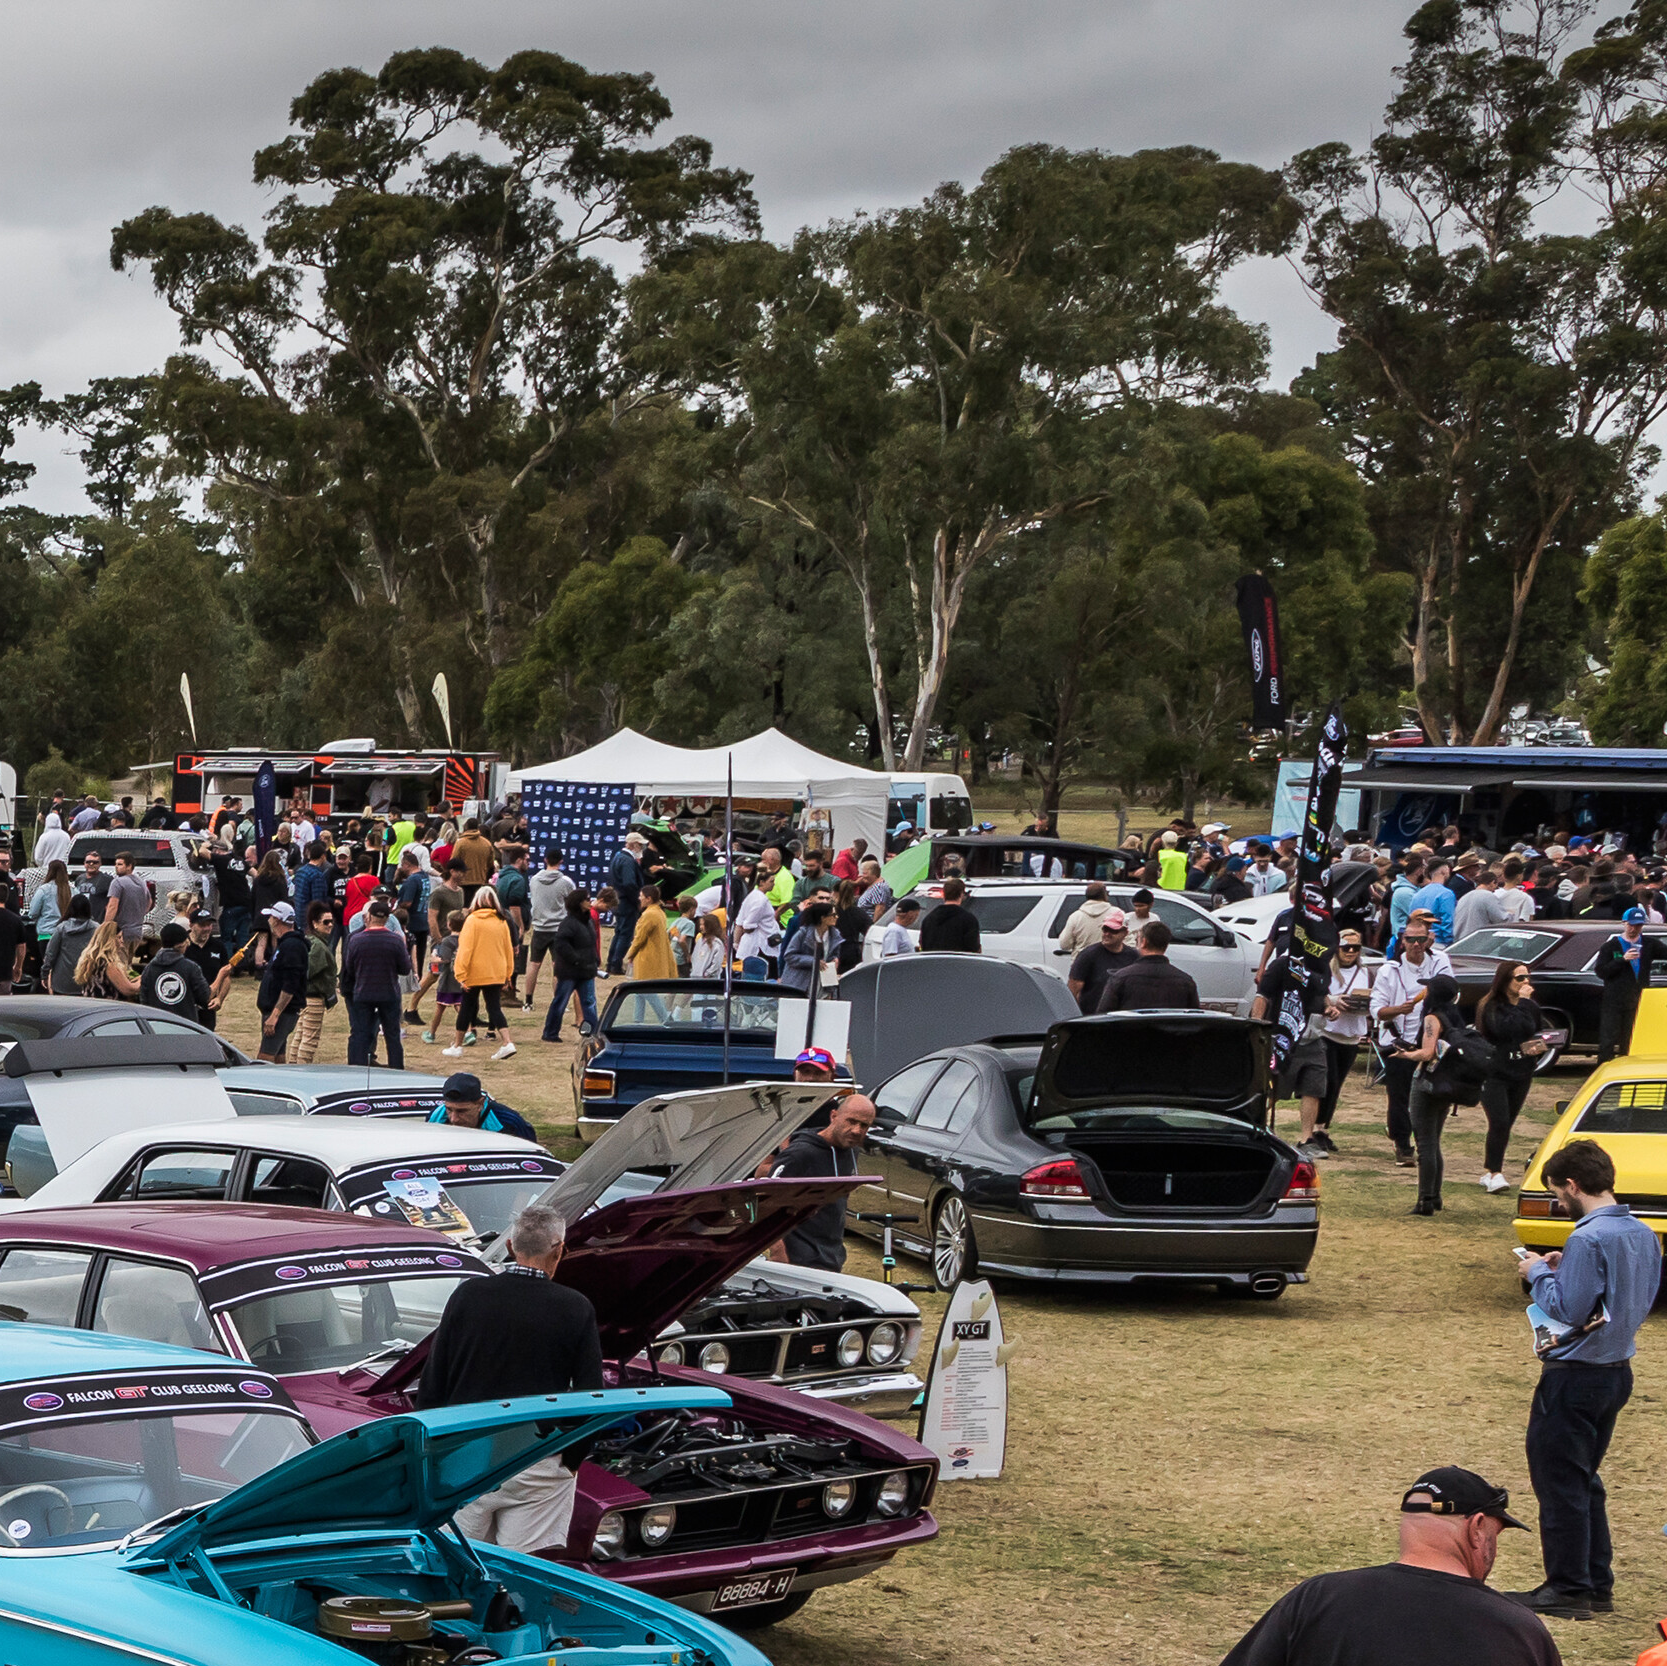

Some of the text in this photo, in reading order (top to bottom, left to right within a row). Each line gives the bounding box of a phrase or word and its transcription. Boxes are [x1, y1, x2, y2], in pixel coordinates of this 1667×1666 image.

[1269, 676, 1280, 705] FORD
[372, 1101, 399, 1109] FALCON
[418, 1162, 520, 1176] FALCON GT CLUB GEELONG
[308, 1256, 435, 1274] FALCON GT CLUB GEELONG
[956, 1322, 987, 1335] XY GT
[66, 1382, 236, 1403] FALCON GT CLUB GEELONG
